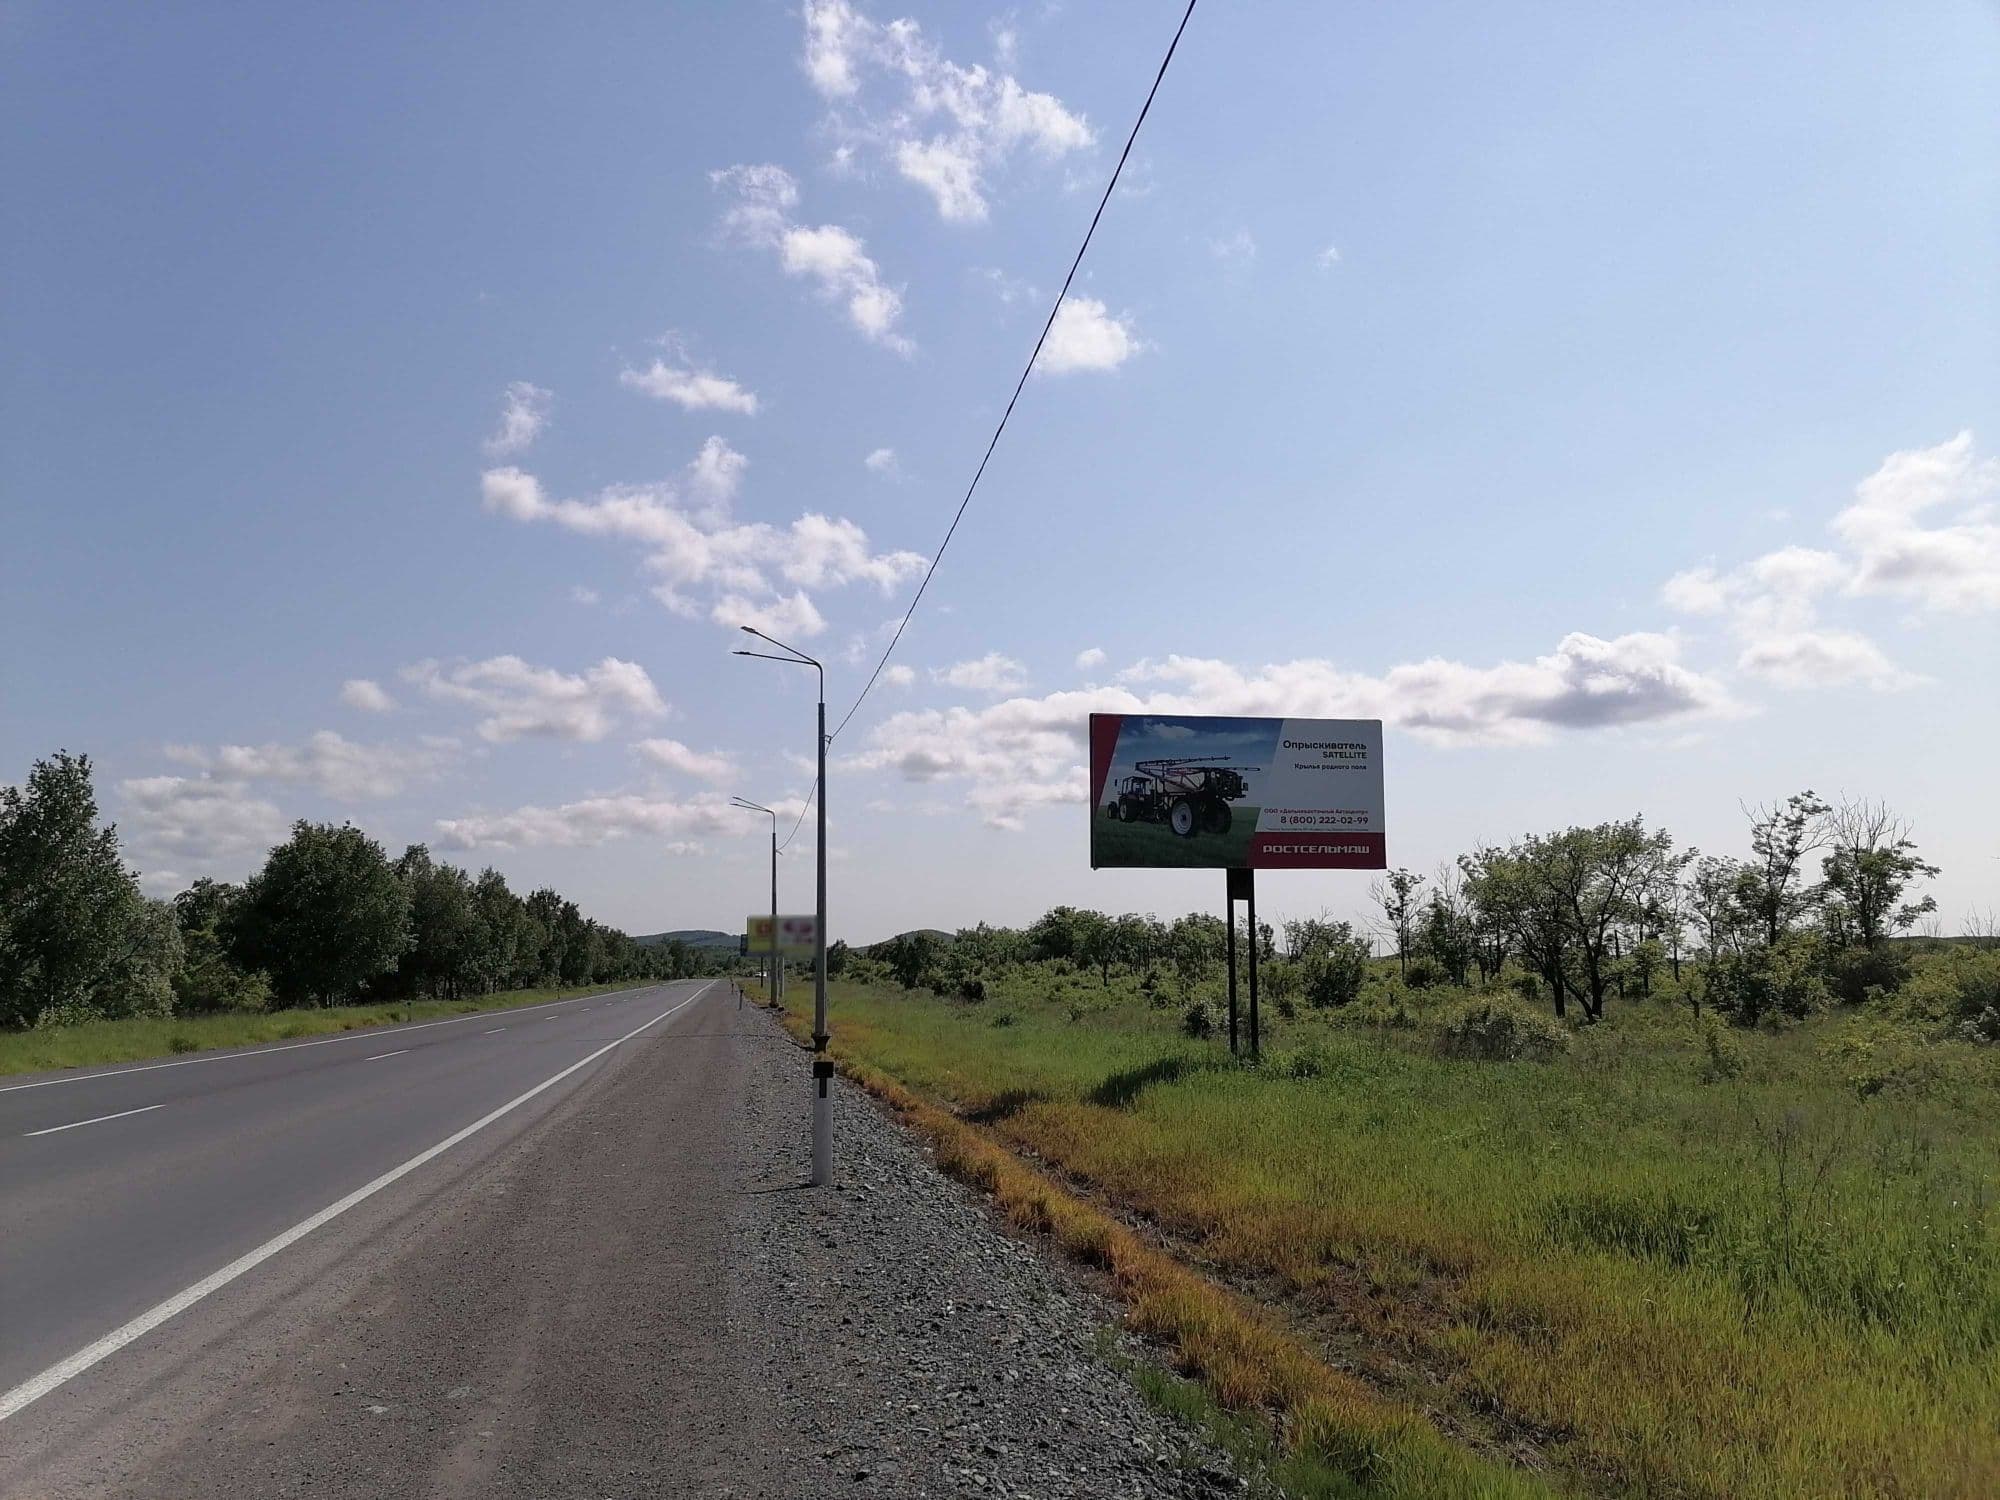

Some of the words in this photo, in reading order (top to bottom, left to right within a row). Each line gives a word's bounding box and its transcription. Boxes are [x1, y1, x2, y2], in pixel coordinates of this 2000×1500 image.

[1282, 740, 1367, 751] Опрыскиватель
[1322, 751, 1368, 759] SATELLITE
[1280, 816, 1286, 824] 8
[1289, 816, 1316, 825] (800)
[1318, 816, 1369, 824] 222-02-99
[1263, 845, 1370, 854] РОСТСЕЛЬМАШ
